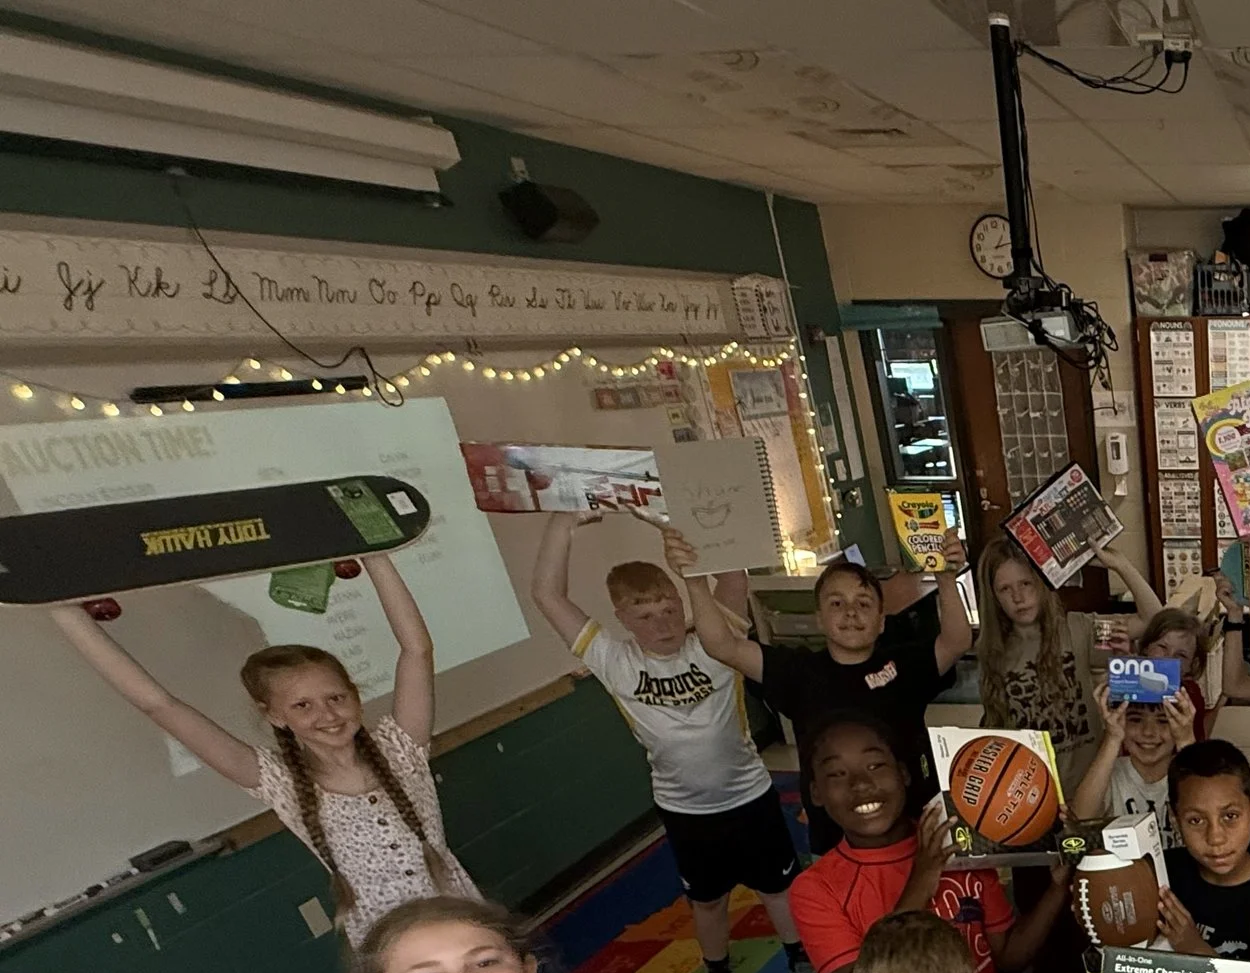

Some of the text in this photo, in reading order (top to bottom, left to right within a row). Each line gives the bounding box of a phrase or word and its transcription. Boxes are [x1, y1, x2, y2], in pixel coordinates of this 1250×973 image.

[1160, 321, 1183, 329] NOUNS
[1164, 401, 1186, 409] VERBS
[2, 425, 218, 477] AUCTION TIME!
[901, 501, 935, 509] Crayola
[140, 519, 271, 556] TONY HAWK
[908, 533, 945, 544] COLORED
[1109, 658, 1154, 675] onn
[962, 775, 985, 806] GRIP
[997, 757, 1038, 825] ATHLETIC
